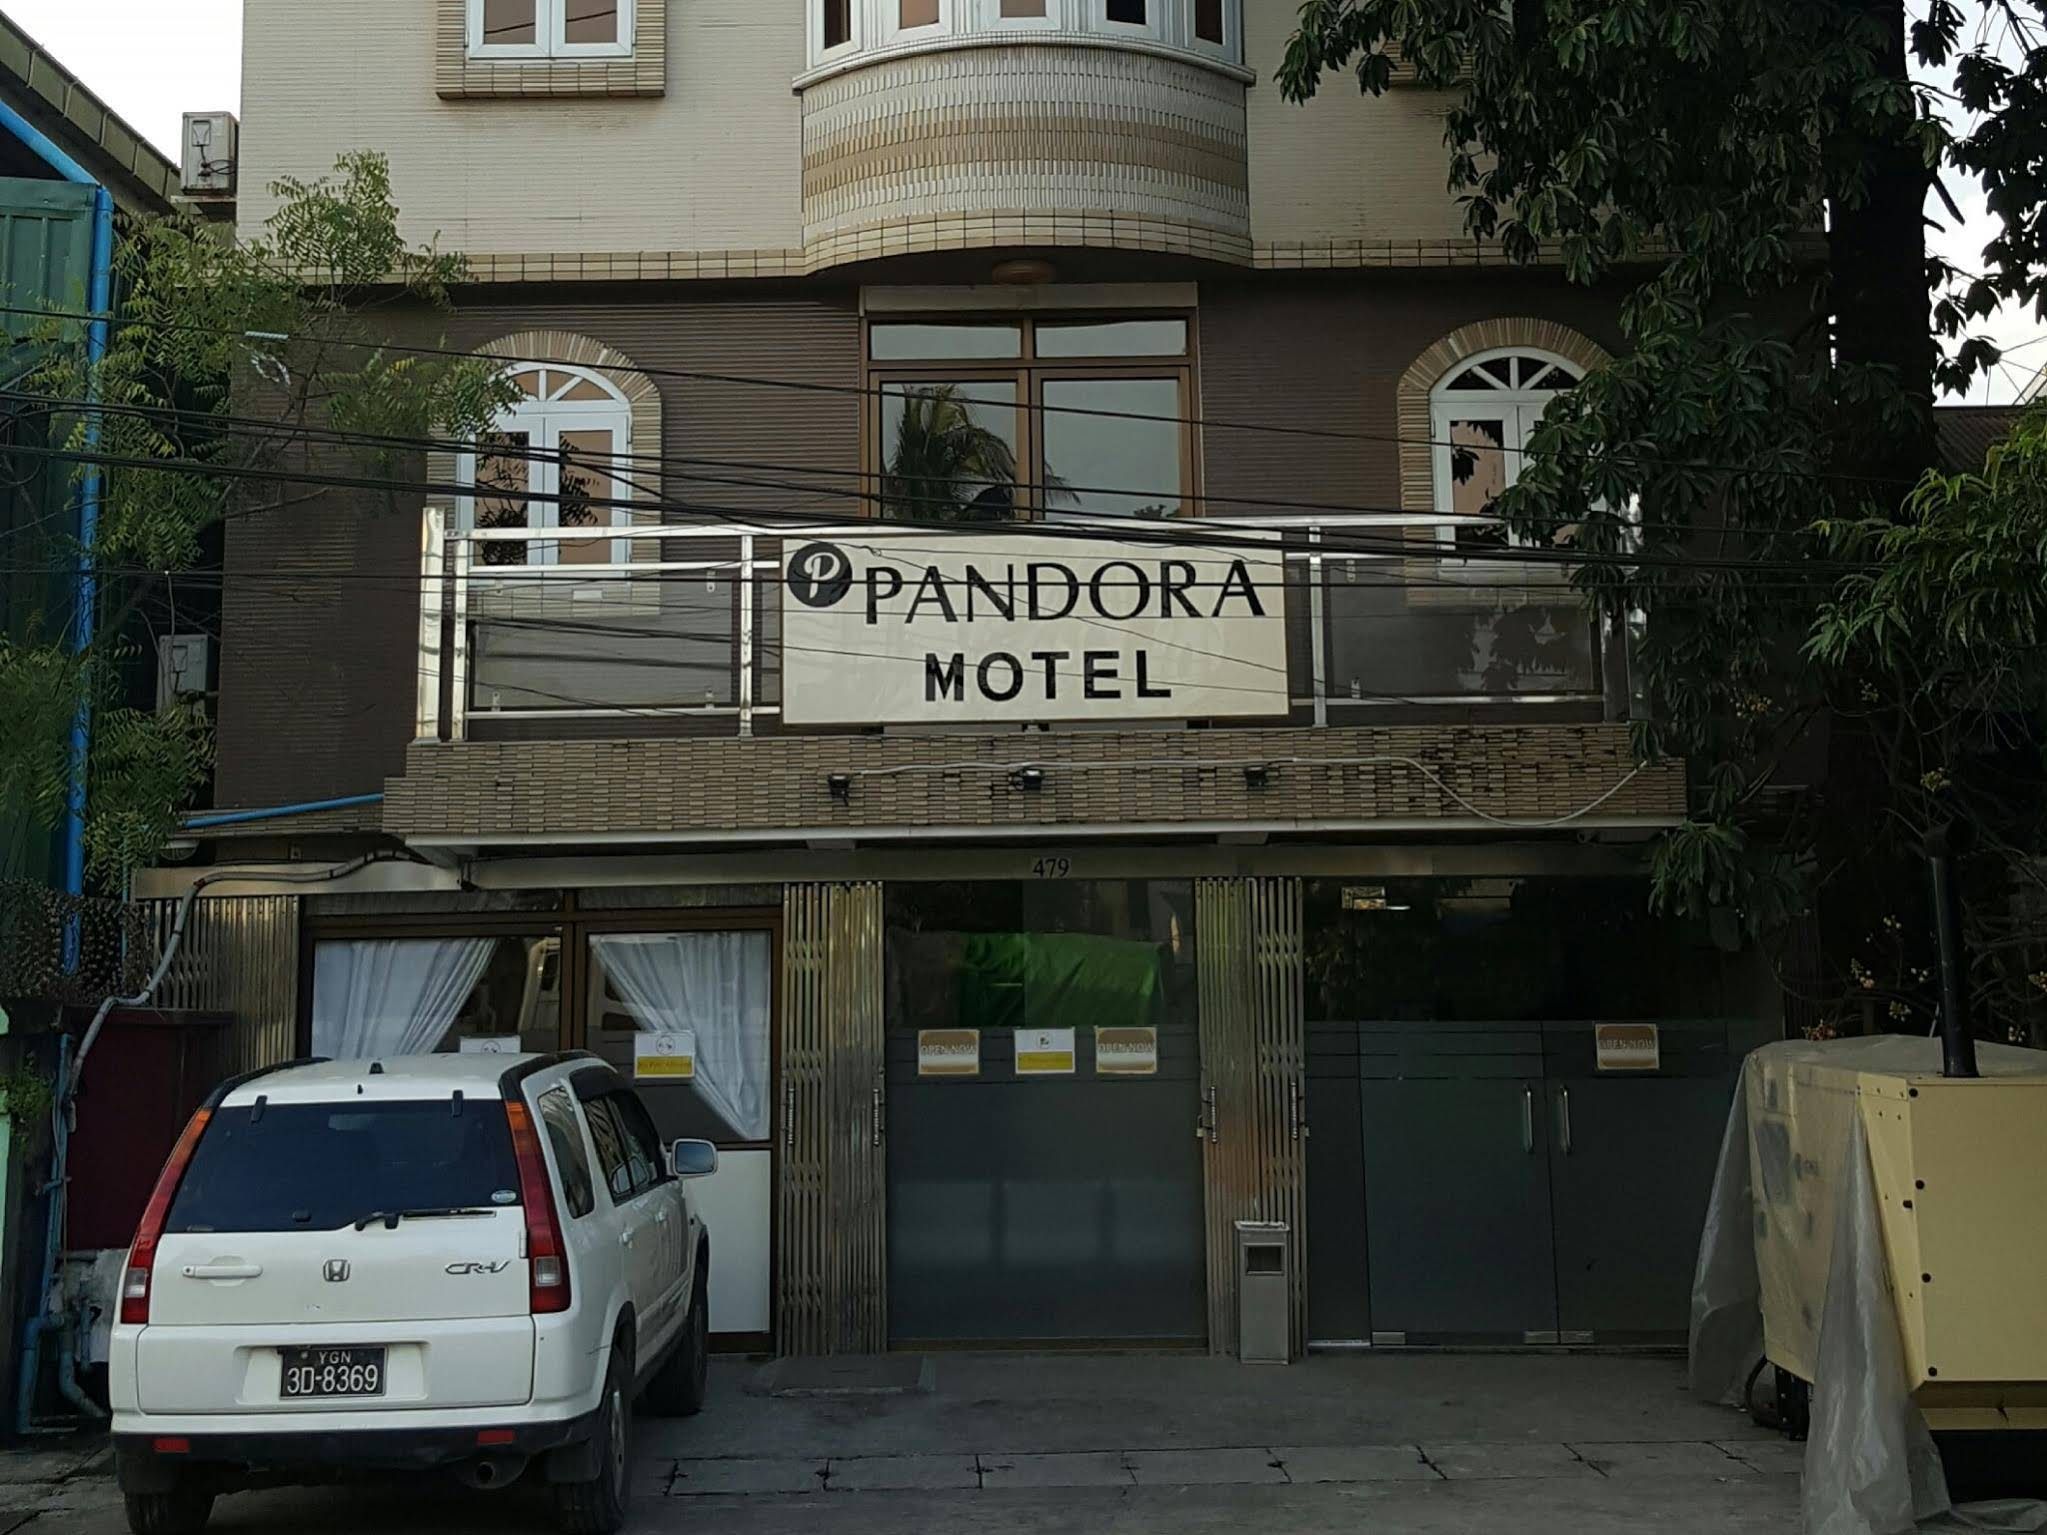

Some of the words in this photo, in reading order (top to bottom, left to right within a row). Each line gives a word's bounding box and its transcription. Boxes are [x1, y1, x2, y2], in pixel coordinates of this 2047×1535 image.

[866, 559, 1266, 624] PANDORA
[925, 650, 1172, 702] MOTEL
[1033, 858, 1070, 878] 479
[319, 1351, 352, 1364] YGN
[287, 1364, 379, 1394] 3D-8369
